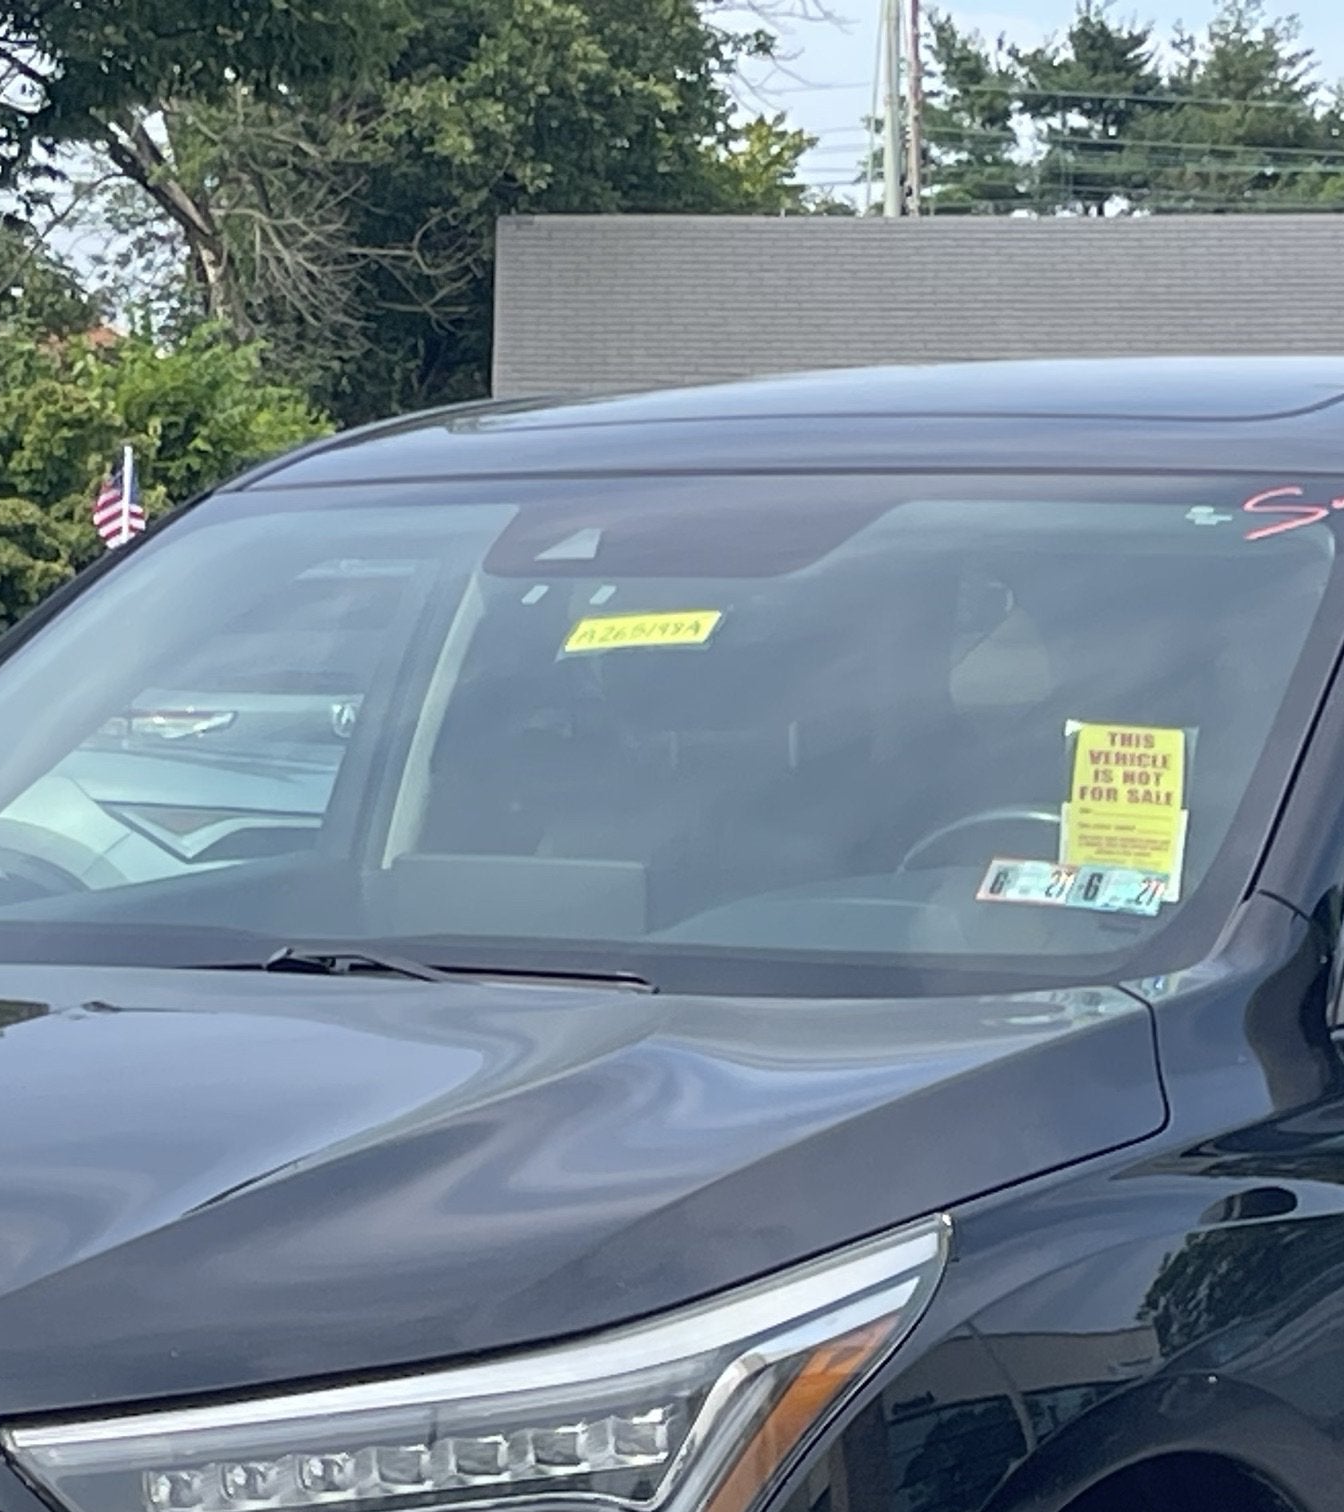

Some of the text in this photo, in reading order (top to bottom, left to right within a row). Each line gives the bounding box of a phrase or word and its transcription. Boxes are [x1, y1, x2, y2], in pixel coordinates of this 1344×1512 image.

[1108, 732, 1155, 749] THIS
[1089, 749, 1170, 769] VEHICLE
[1093, 768, 1163, 787] IS NOT
[1079, 786, 1173, 806] FOR SALE
[1083, 872, 1104, 902] 6
